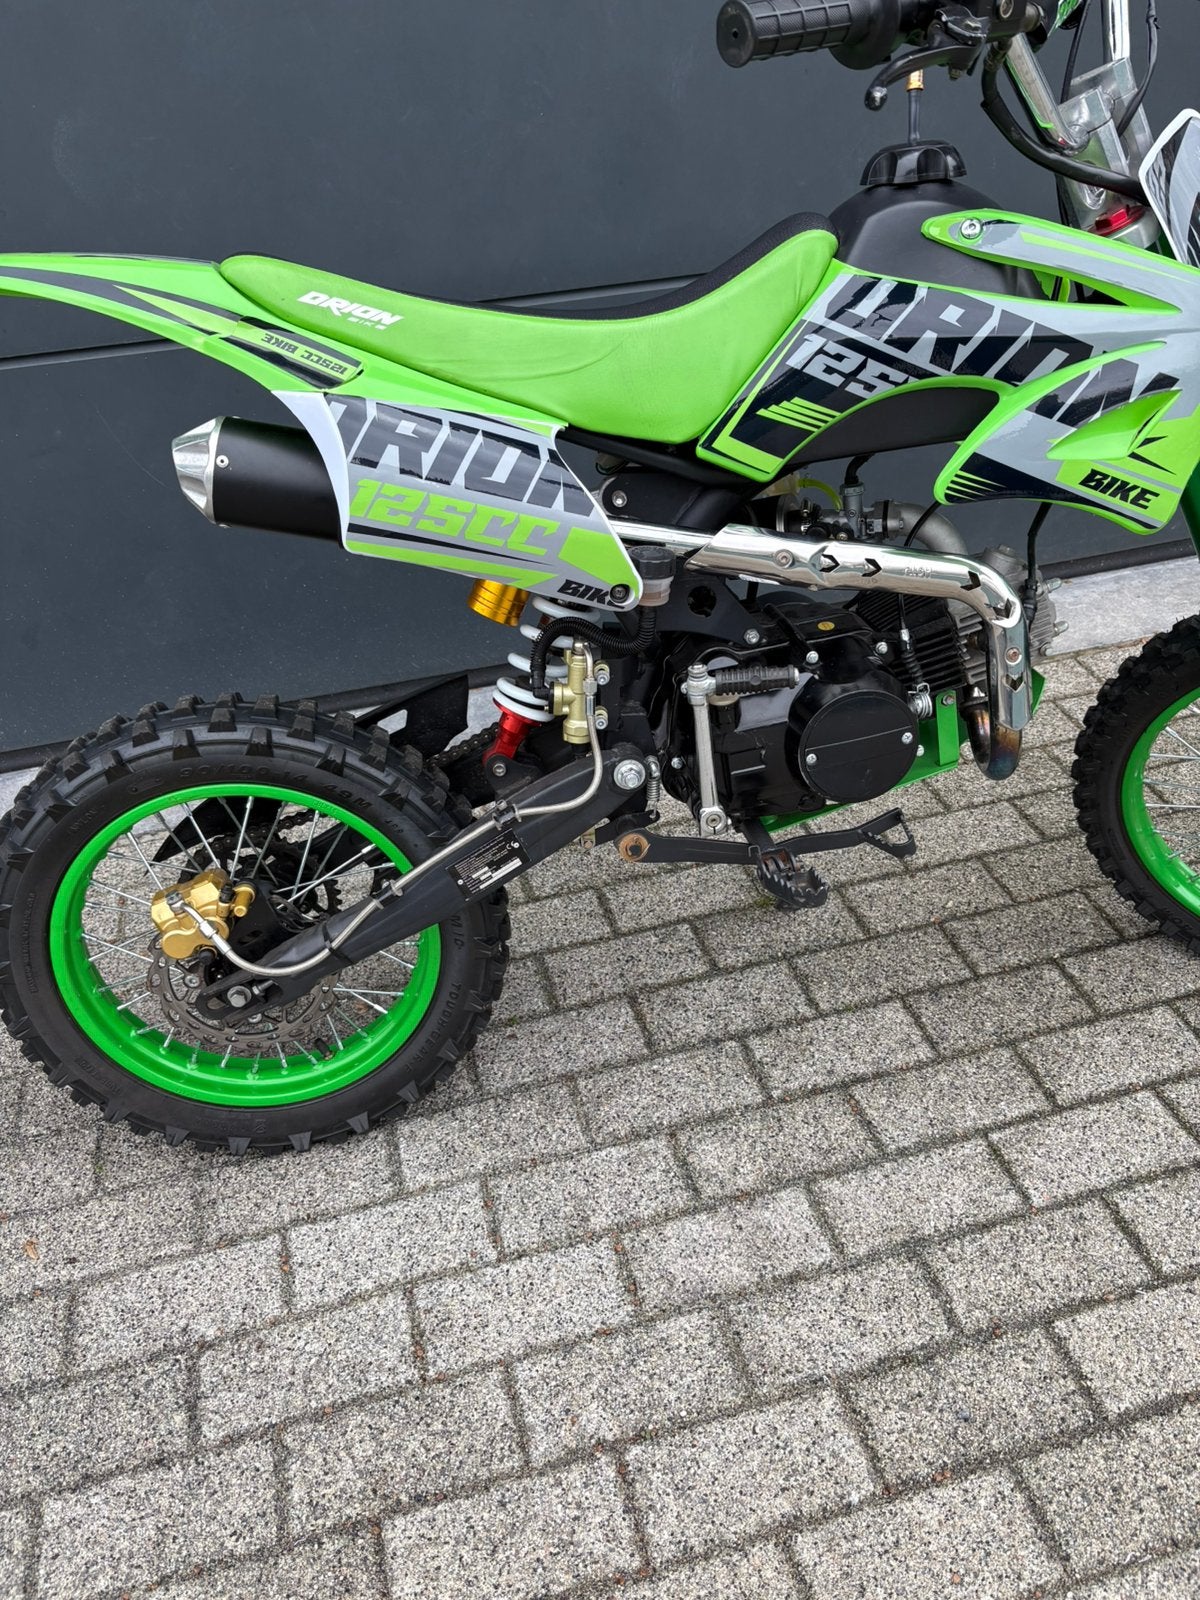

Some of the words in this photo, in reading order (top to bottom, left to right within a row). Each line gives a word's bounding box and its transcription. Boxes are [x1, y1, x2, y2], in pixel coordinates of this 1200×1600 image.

[296, 290, 405, 326] ORION
[261, 332, 300, 355] BIKE
[300, 349, 348, 375] 125CC
[785, 333, 920, 400] 125
[1078, 468, 1161, 510] BIKE
[350, 478, 561, 556] 125CC
